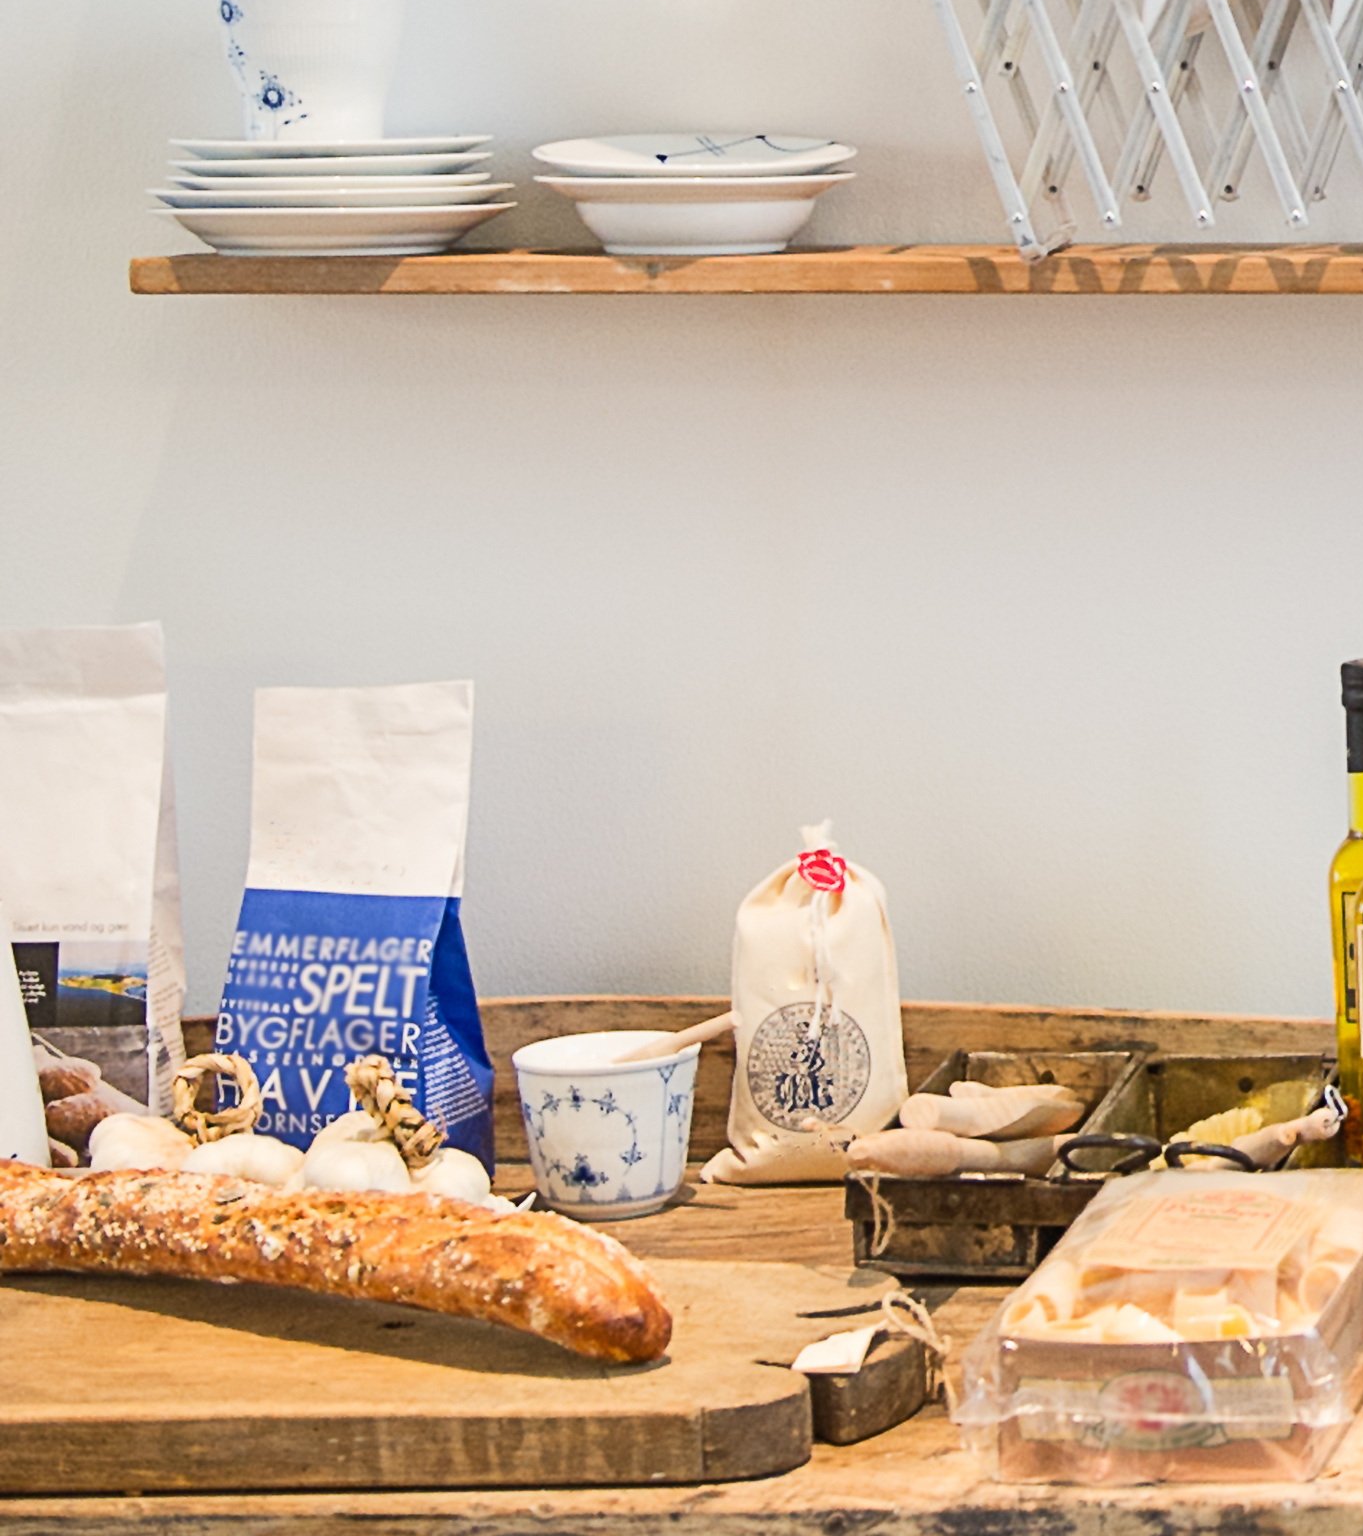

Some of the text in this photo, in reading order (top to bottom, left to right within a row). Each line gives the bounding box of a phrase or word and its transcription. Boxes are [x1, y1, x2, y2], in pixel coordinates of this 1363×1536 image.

[231, 931, 433, 964] EMMERFLAGER
[293, 963, 428, 1019] SPELT
[216, 1013, 421, 1056] BYGFLAGER
[216, 1068, 418, 1112] HAVE
